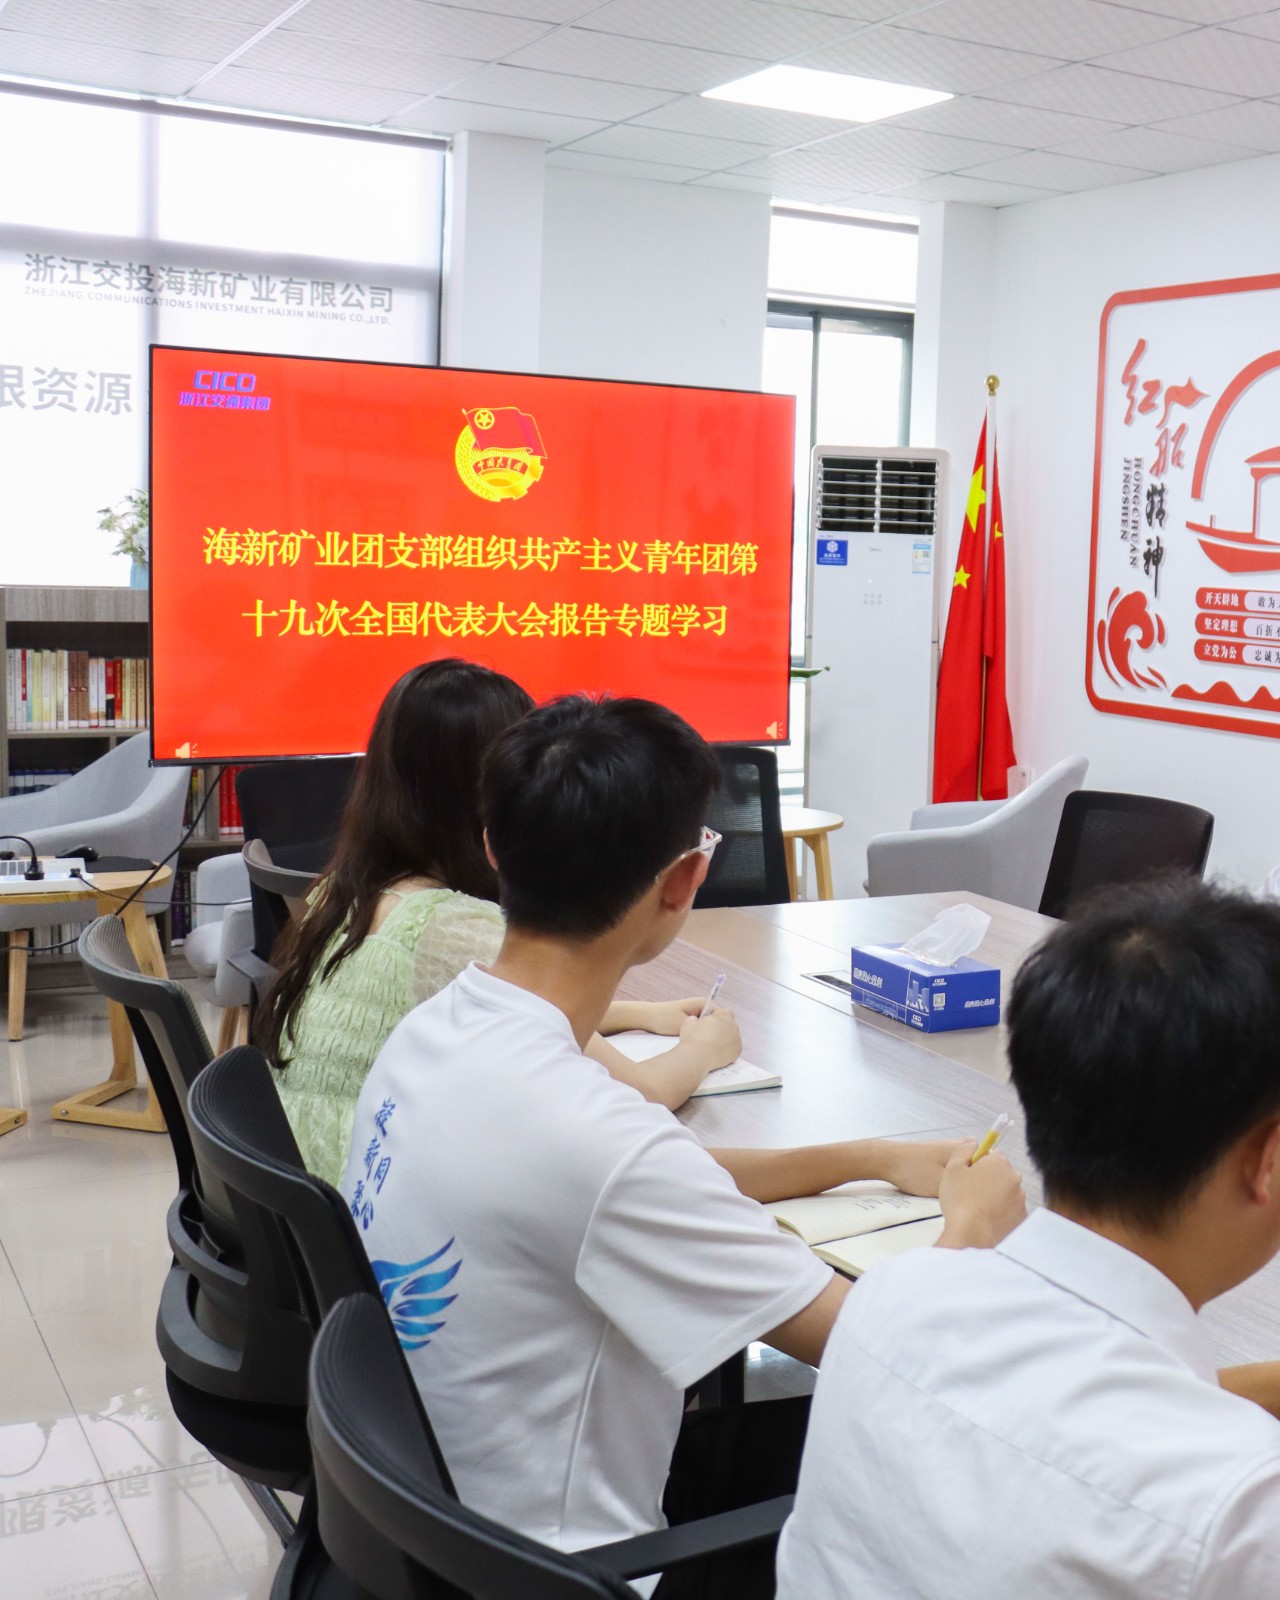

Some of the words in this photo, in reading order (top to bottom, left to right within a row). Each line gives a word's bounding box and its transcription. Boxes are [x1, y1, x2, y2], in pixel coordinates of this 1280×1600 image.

[25, 253, 393, 313] 浙江交投海新矿业有限公司
[24, 286, 84, 300] ZHEJIANG
[87, 291, 192, 309] COMMUNICATIONS
[195, 301, 264, 315] INVESTMENT
[267, 307, 303, 318] HAIXIN
[306, 311, 346, 321] MINING
[194, 370, 256, 392] CICO
[179, 391, 271, 411] 浙江交通集团
[1120, 457, 1132, 541] JINGSHEN
[1130, 457, 1143, 567] HONGCHUAN
[203, 527, 758, 576] 海新矿业团支部组织共产主义青年团第
[1204, 592, 1239, 607] 开天辟地
[242, 599, 727, 637] 十九次全国代表大会报告专题学习
[1204, 617, 1238, 633] 坚定理想
[1203, 643, 1237, 659] 立党为公
